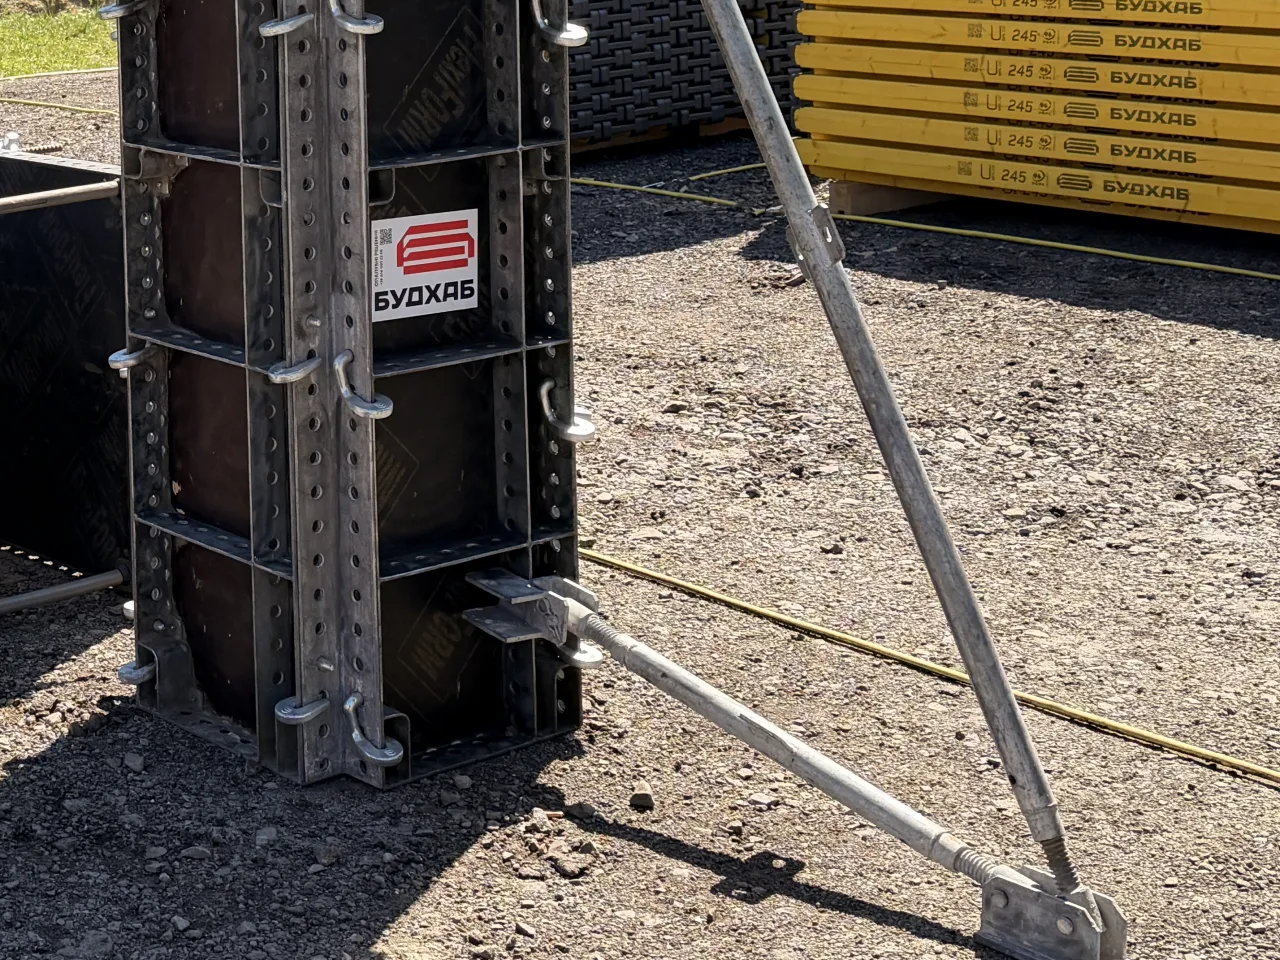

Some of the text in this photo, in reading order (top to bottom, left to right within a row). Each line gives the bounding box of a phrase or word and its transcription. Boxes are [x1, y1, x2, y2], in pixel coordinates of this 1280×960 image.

[1011, 29, 1037, 42] 245
[1114, 34, 1202, 52] БУДХАБ
[1007, 64, 1034, 78] 245
[1110, 70, 1197, 89] БУДХАБ
[1007, 99, 1034, 113] 245
[1110, 107, 1197, 127] БУДХАБ
[1008, 134, 1034, 148] 245
[1110, 143, 1197, 164] БУДХАБ
[1001, 169, 1027, 183] 245
[1103, 179, 1190, 201] БУДХАБ
[374, 278, 475, 312] БУДХАБ
